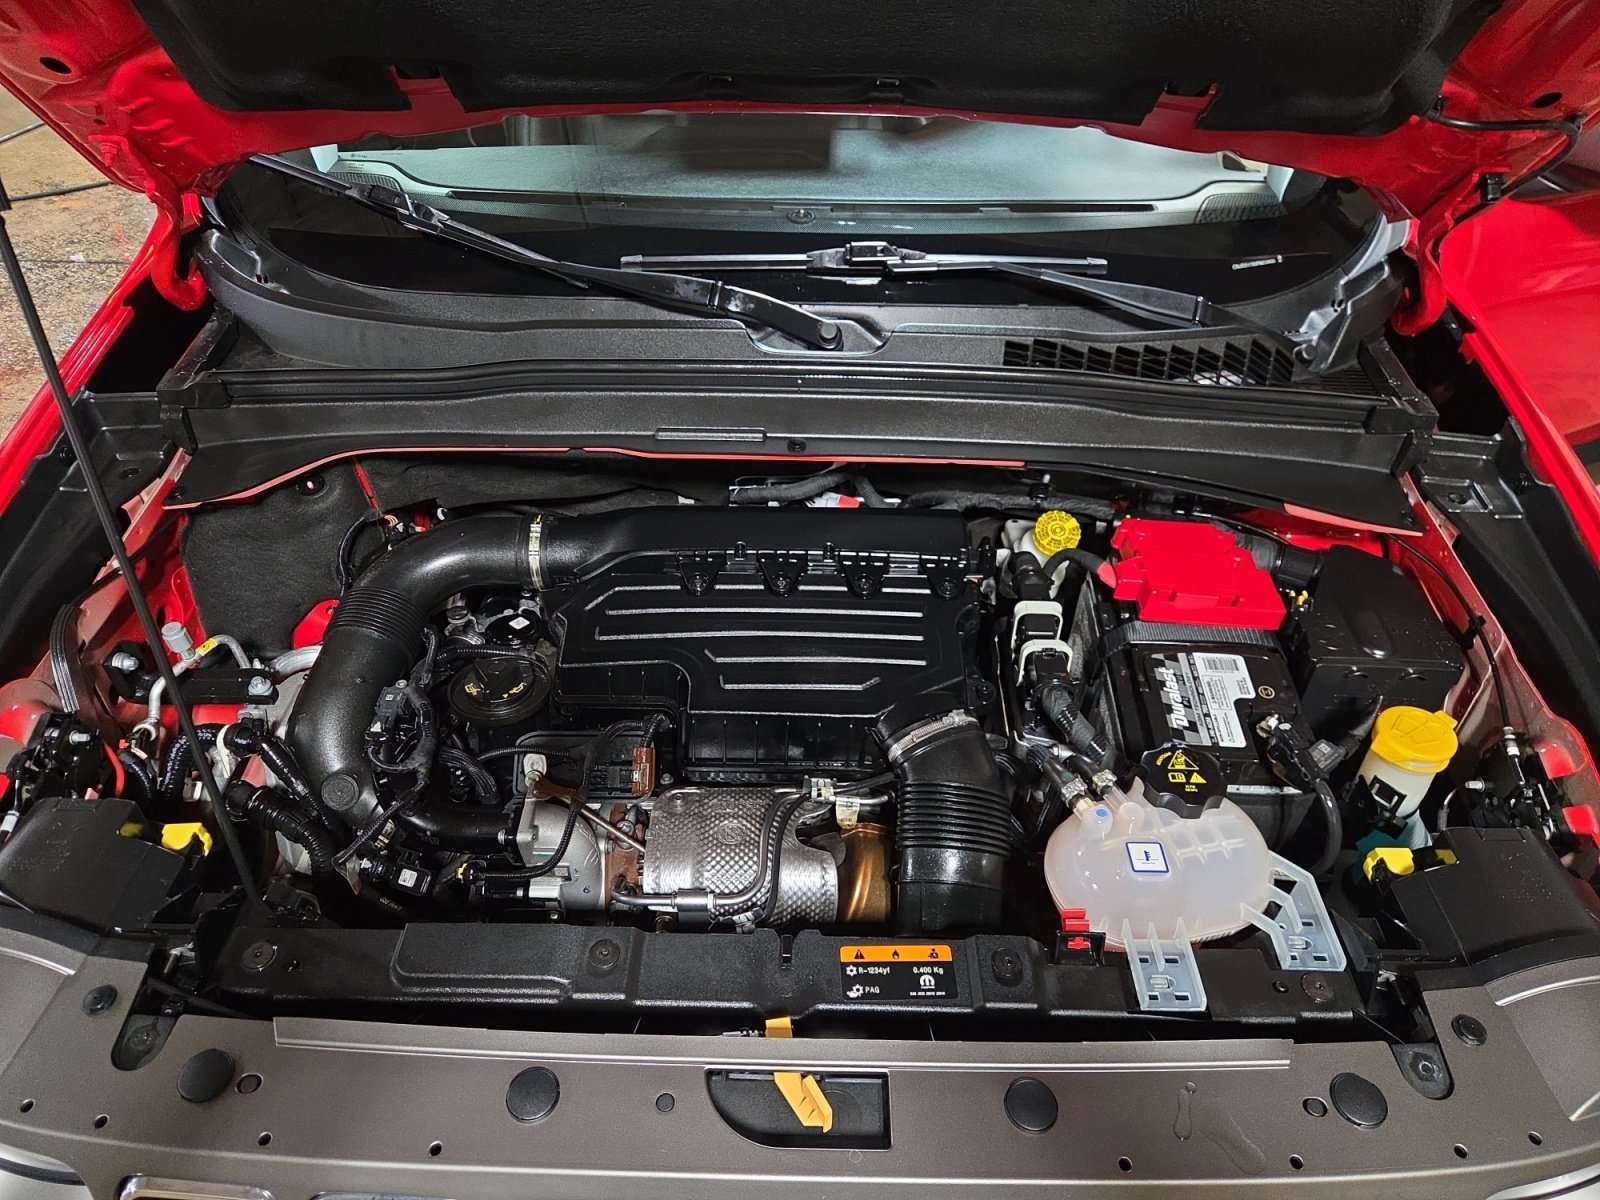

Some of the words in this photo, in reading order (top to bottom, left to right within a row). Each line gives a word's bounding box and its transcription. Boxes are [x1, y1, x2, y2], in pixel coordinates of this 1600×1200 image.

[1158, 666, 1190, 728] Duralast
[933, 966, 944, 975] Kg
[865, 986, 880, 994] PAG
